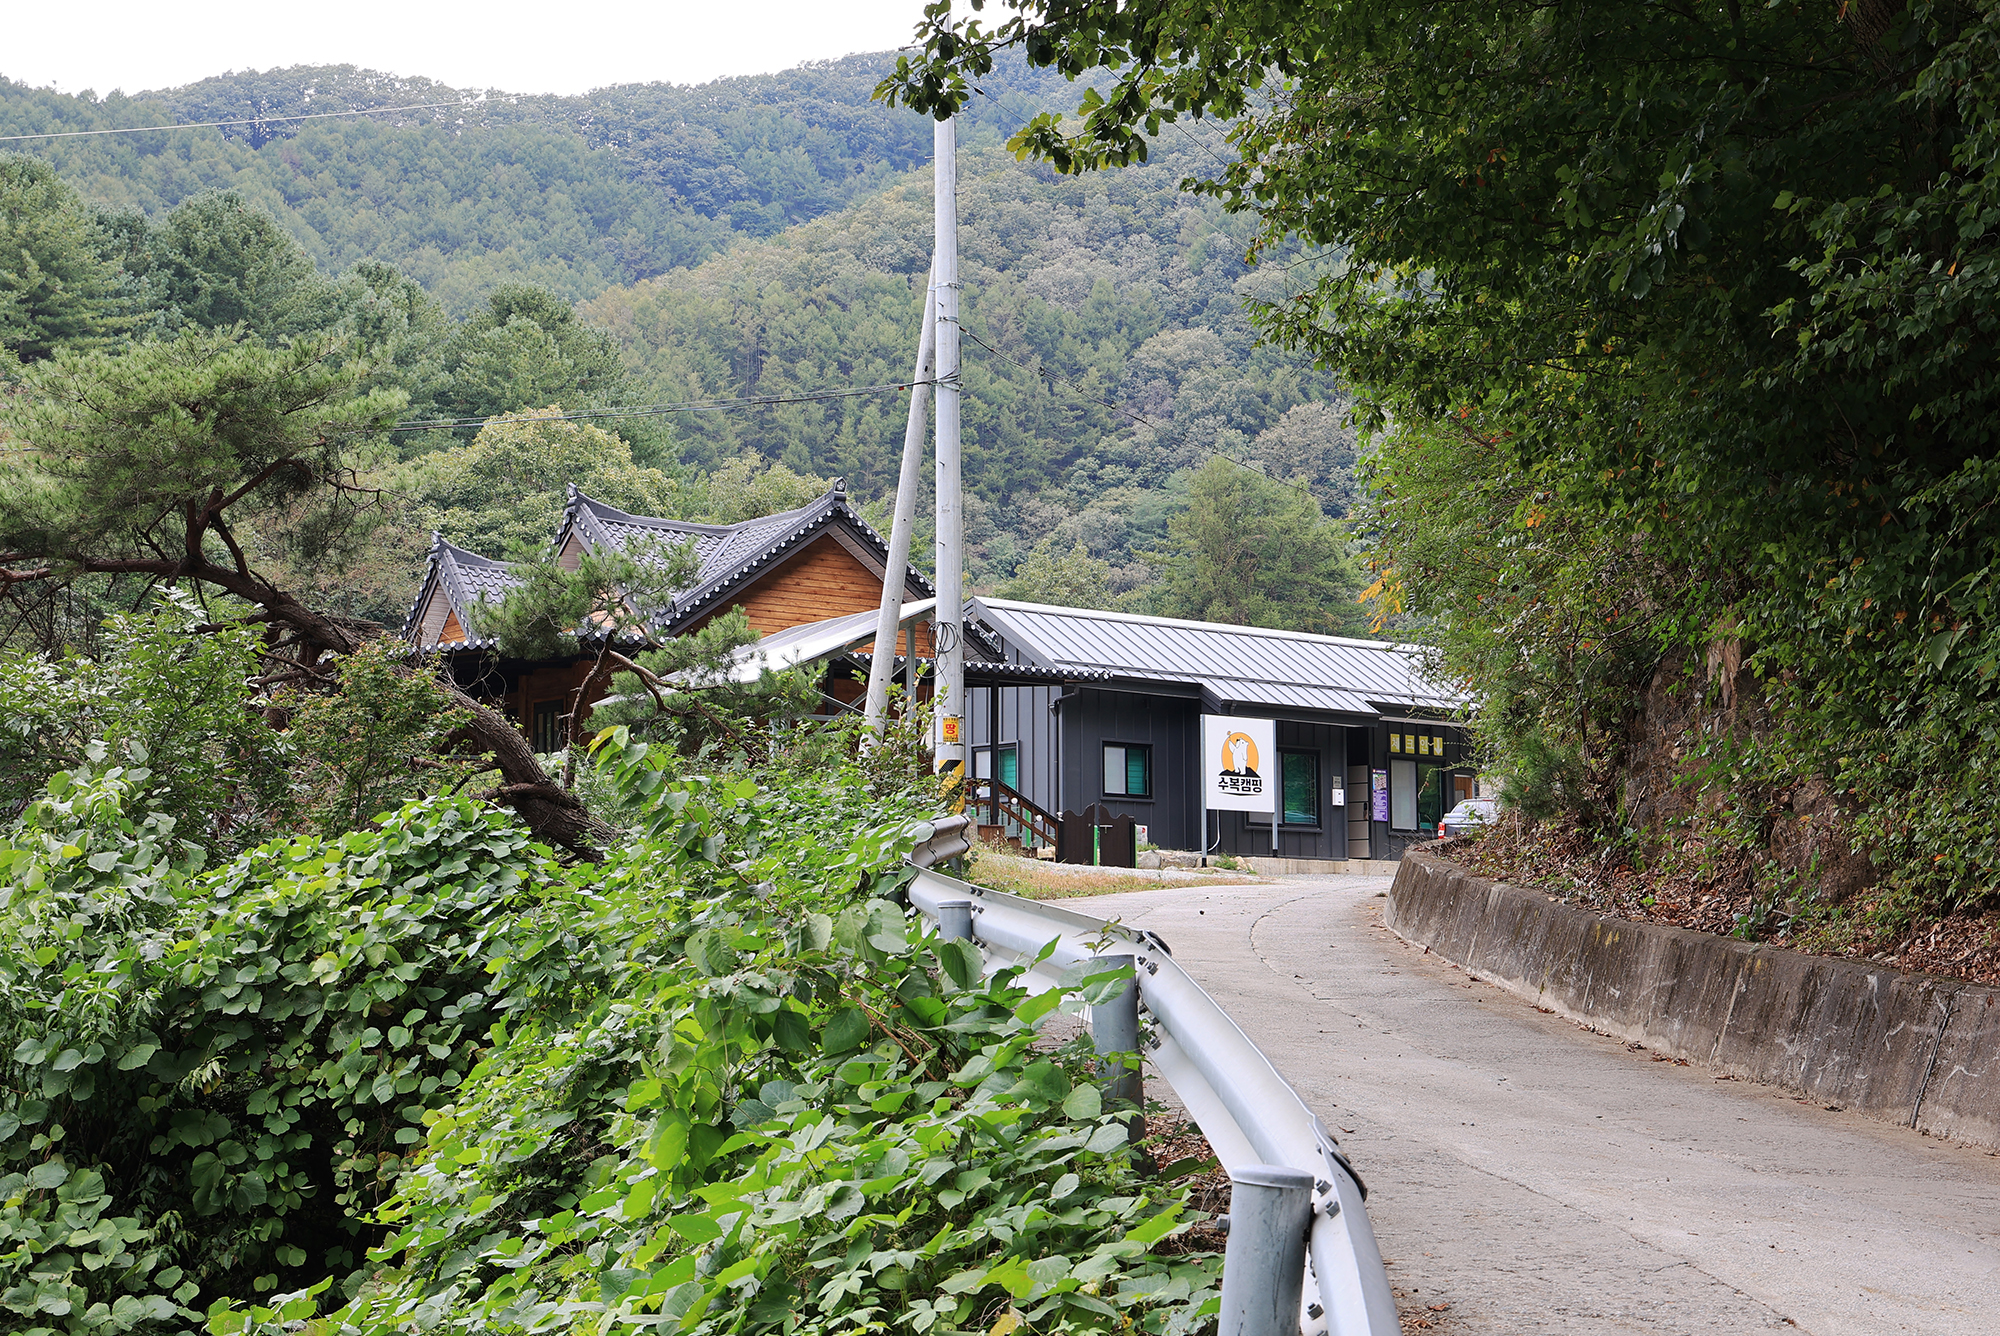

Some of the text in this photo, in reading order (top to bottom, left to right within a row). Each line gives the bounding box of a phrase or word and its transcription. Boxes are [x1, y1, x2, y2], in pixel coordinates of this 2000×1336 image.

[945, 723, 956, 734] 땅
[1391, 736, 1429, 752] 체크인
[1218, 777, 1262, 793] 수복캠핑
